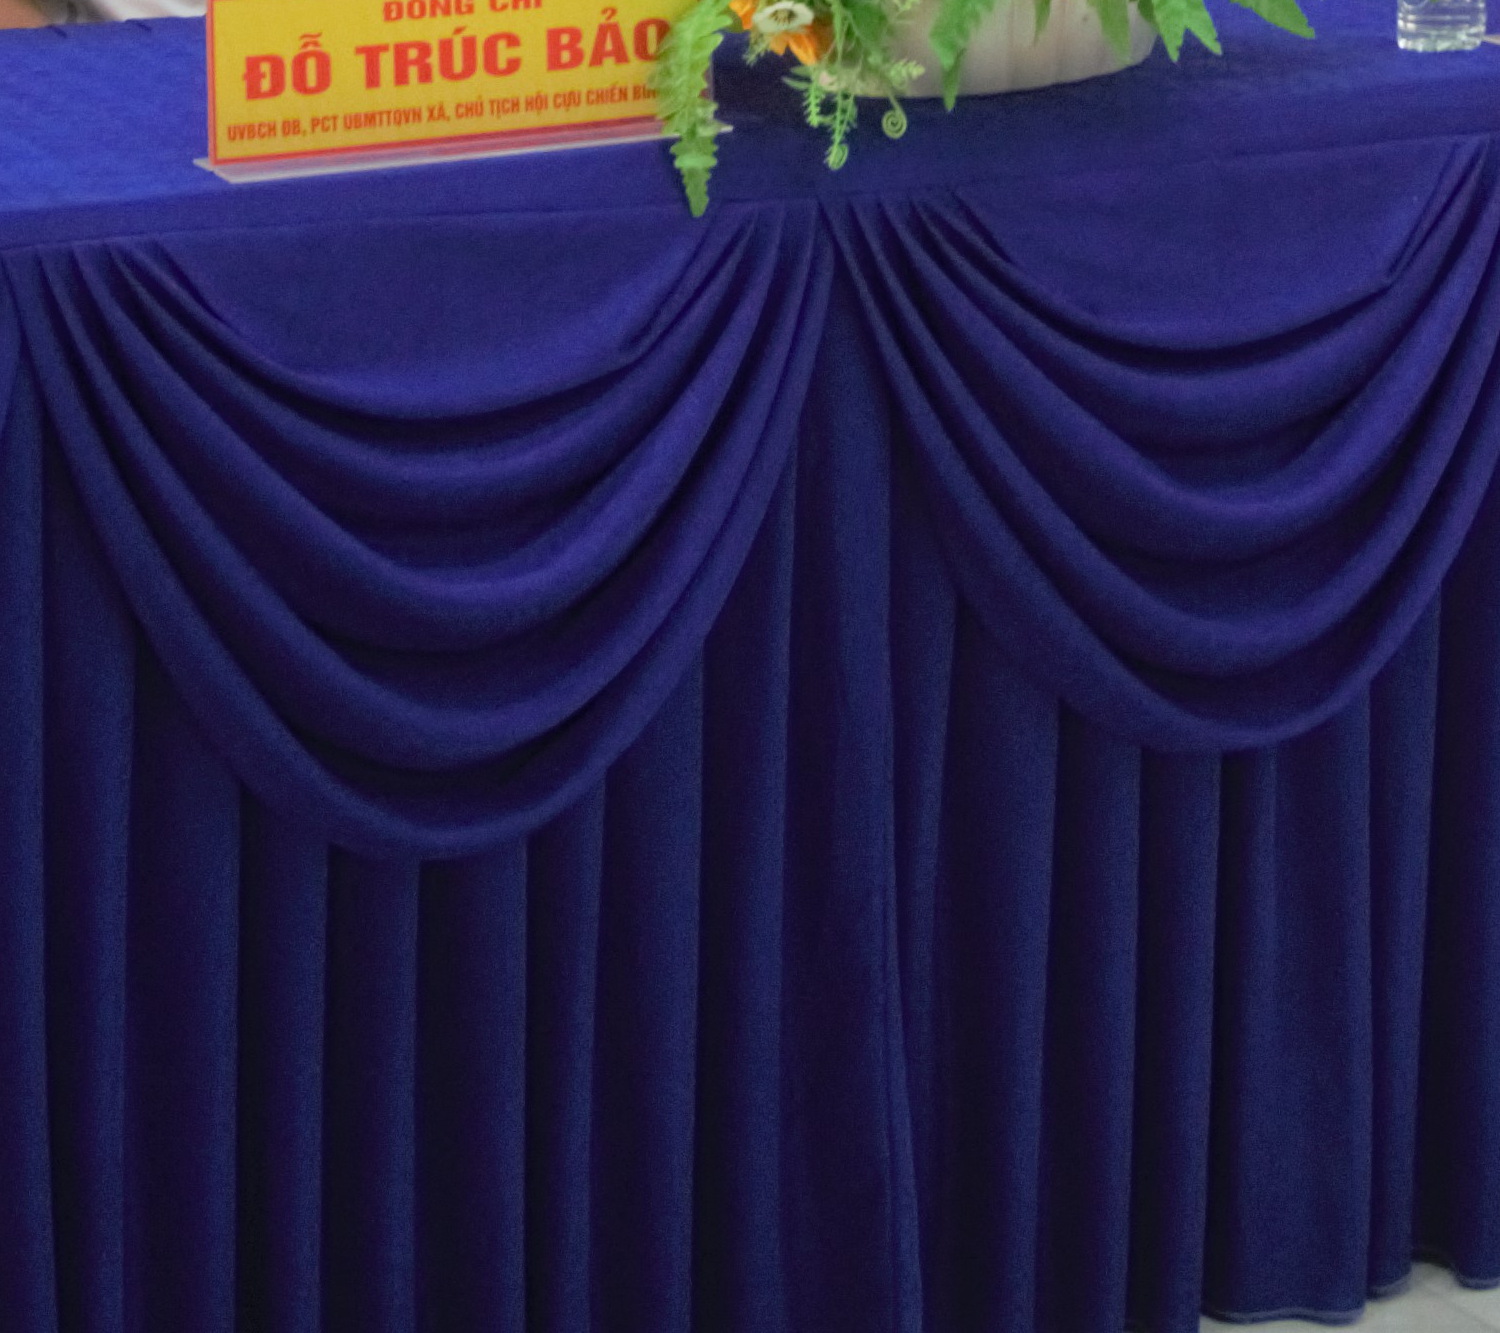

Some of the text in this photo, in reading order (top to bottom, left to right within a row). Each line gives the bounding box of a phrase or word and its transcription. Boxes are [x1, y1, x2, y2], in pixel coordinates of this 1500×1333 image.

[242, 5, 673, 102] ĐỖ TRÚC BẢO
